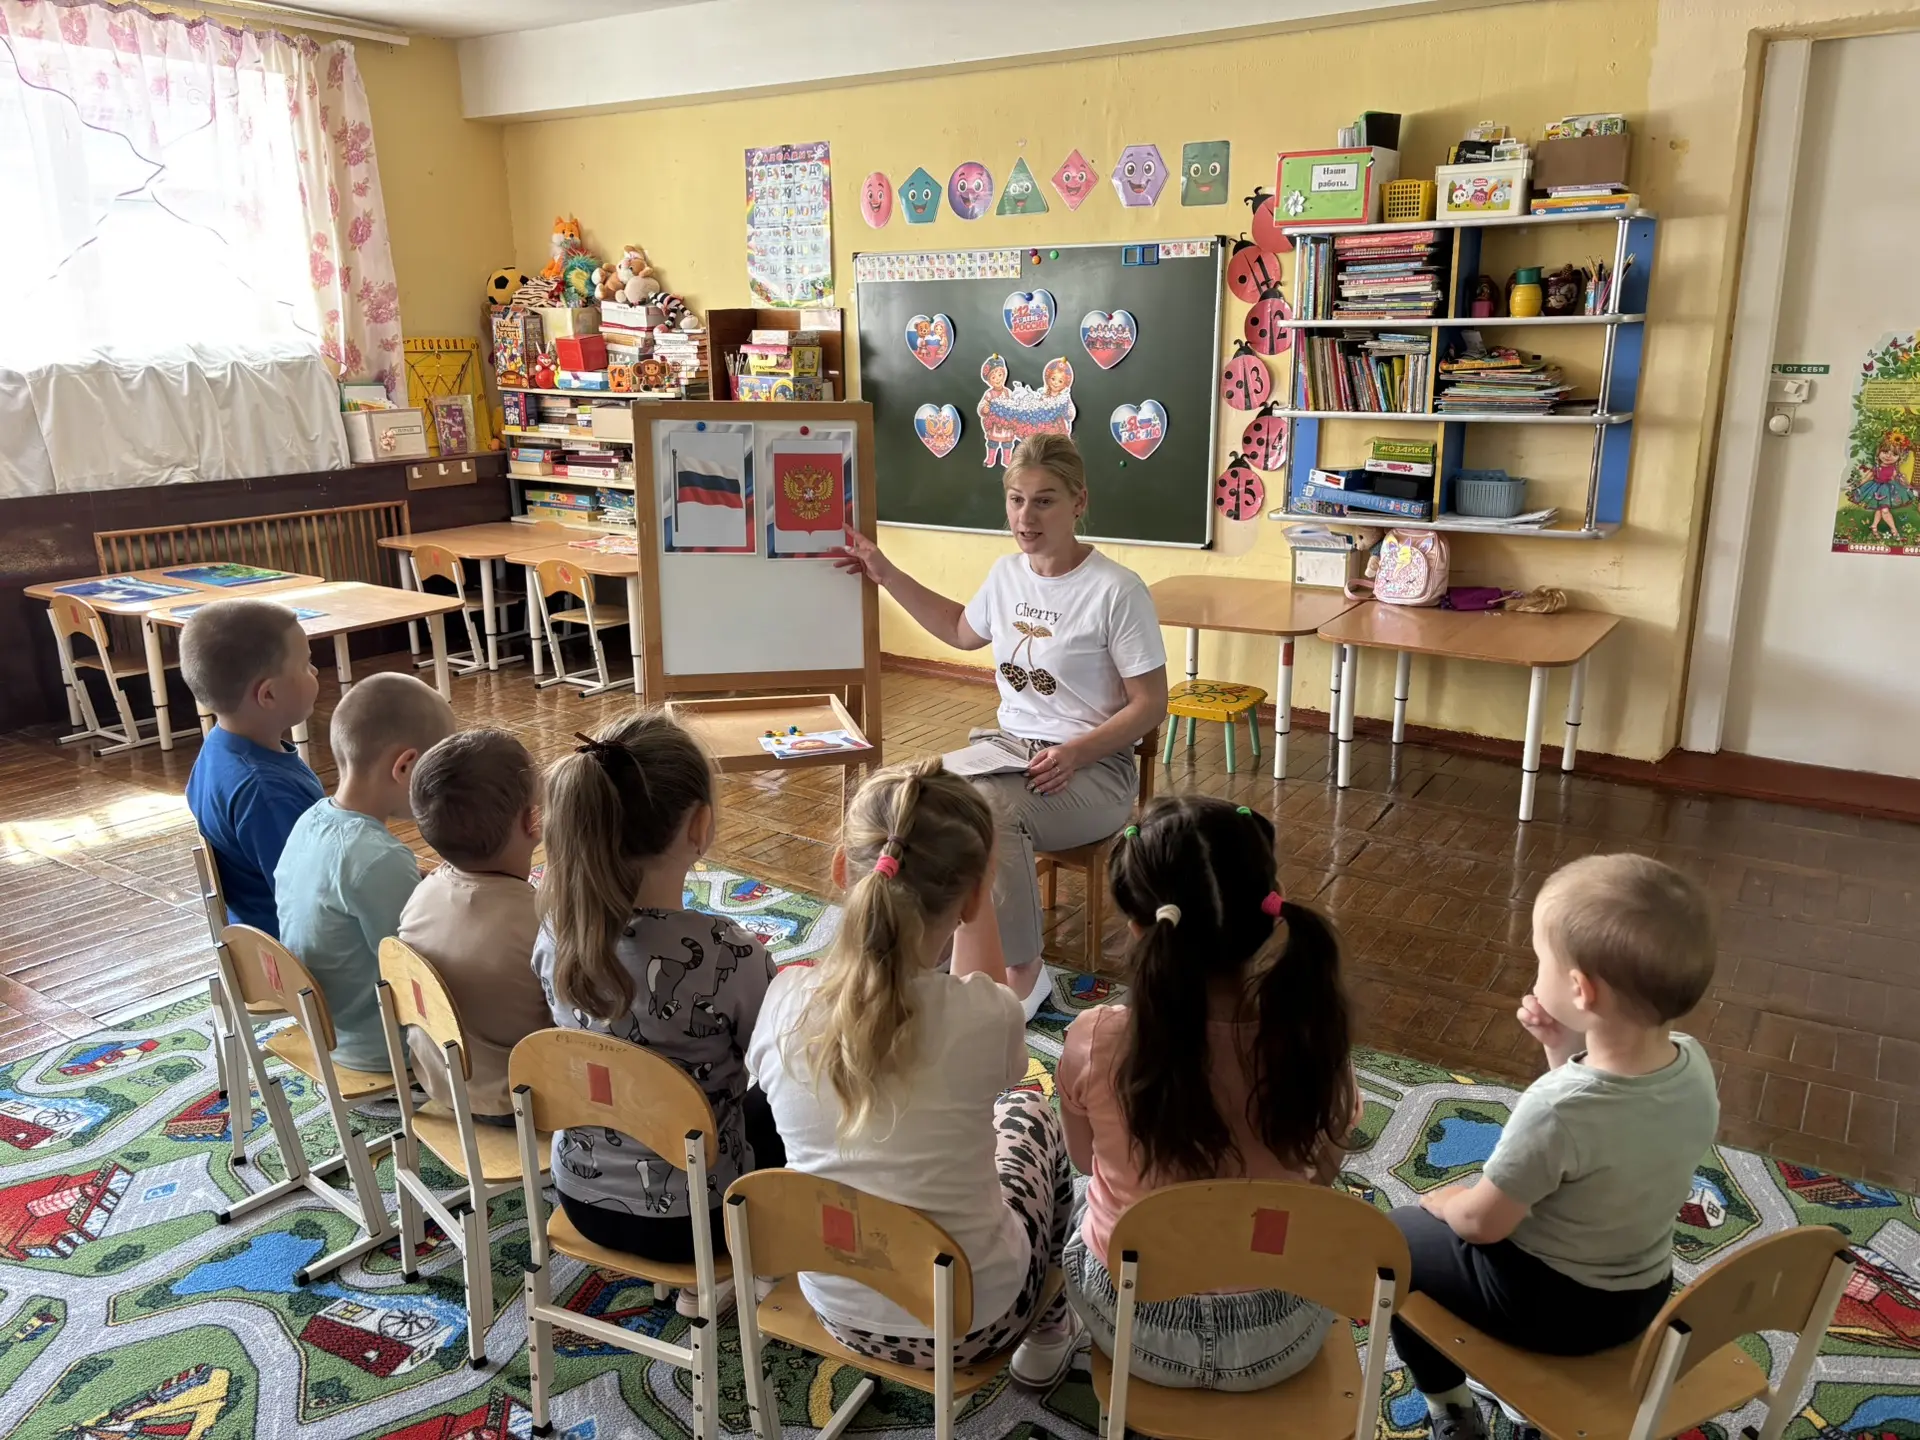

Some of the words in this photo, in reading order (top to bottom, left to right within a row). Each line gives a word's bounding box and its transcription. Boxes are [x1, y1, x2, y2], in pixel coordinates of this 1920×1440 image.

[1322, 167, 1346, 175] Наши
[1251, 366, 1263, 394] 3
[1272, 428, 1283, 456] 4
[1244, 479, 1256, 506] 5
[1015, 602, 1062, 625] Cherry
[66, 1196, 91, 1224] SUPER
